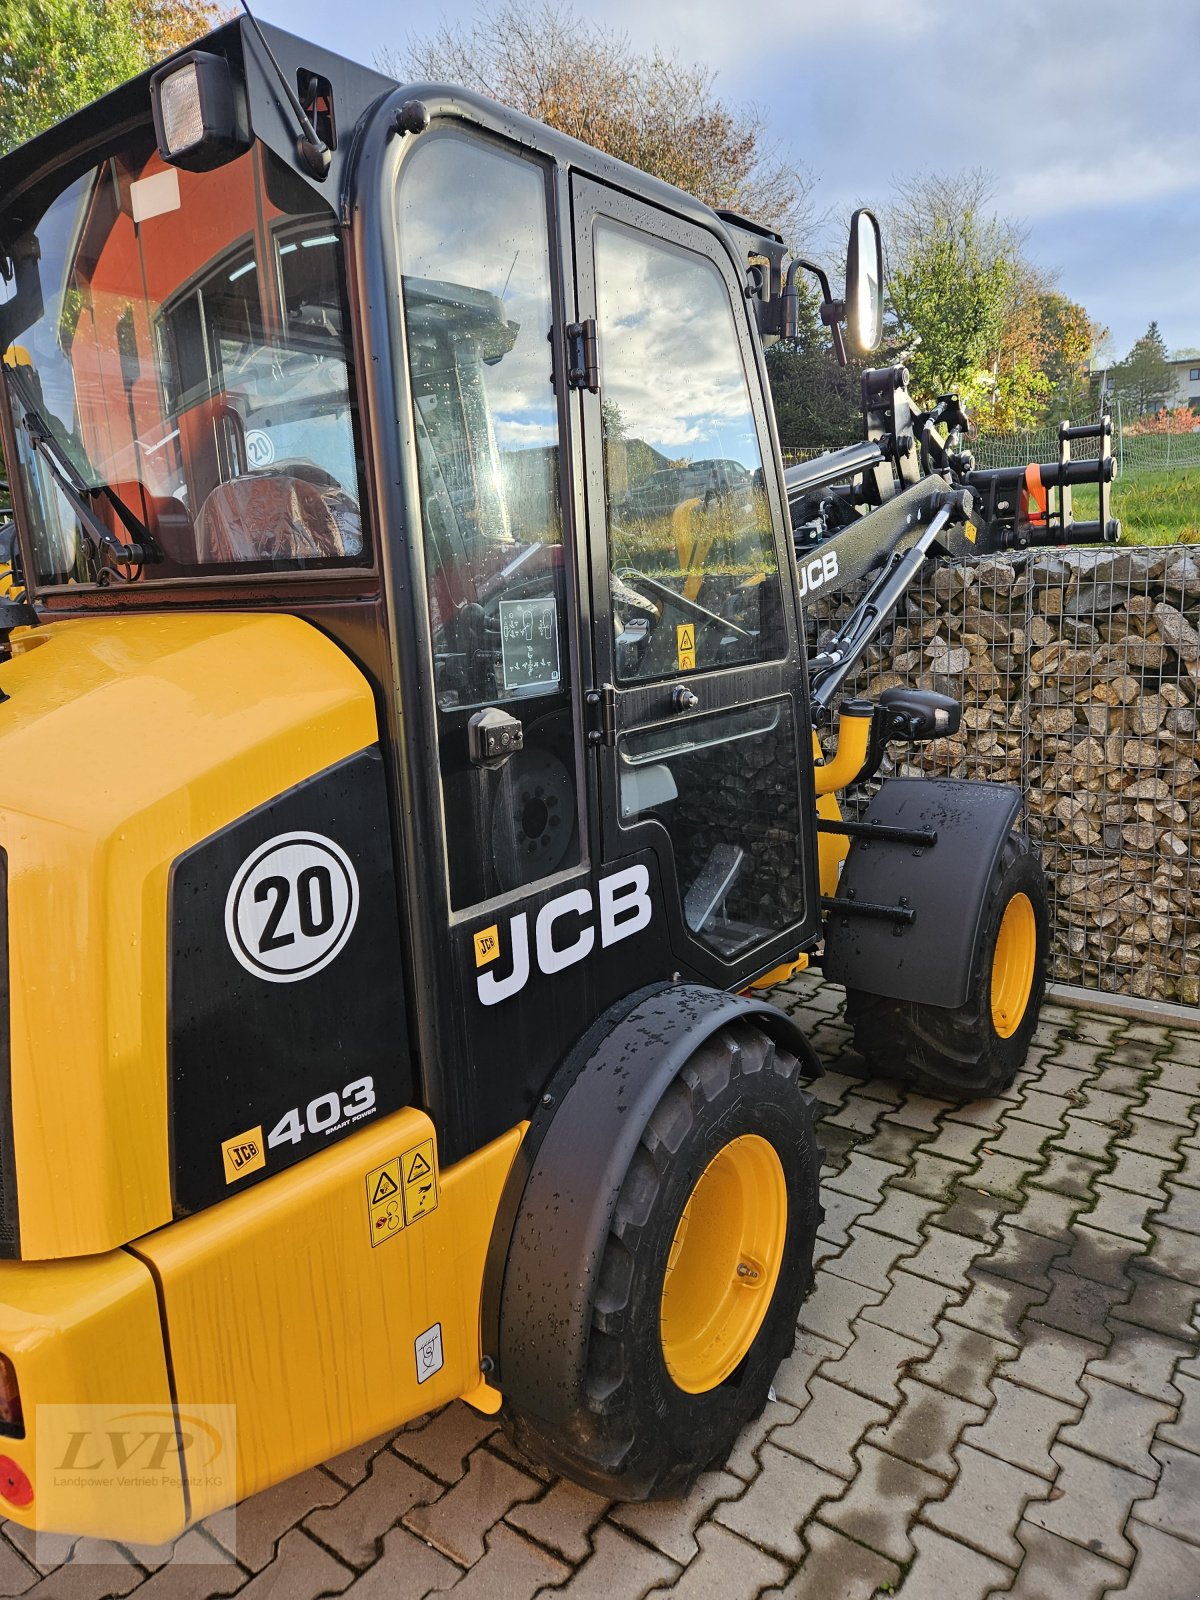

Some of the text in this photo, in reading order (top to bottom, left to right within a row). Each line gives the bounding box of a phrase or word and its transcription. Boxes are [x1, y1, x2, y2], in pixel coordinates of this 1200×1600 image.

[249, 437, 270, 462] 20
[254, 865, 335, 954] 20
[476, 864, 652, 1006] JCB
[479, 936, 495, 955] JCB
[267, 1075, 376, 1150] 403
[325, 1106, 377, 1136] SMART POWER
[232, 1142, 257, 1168] JCB
